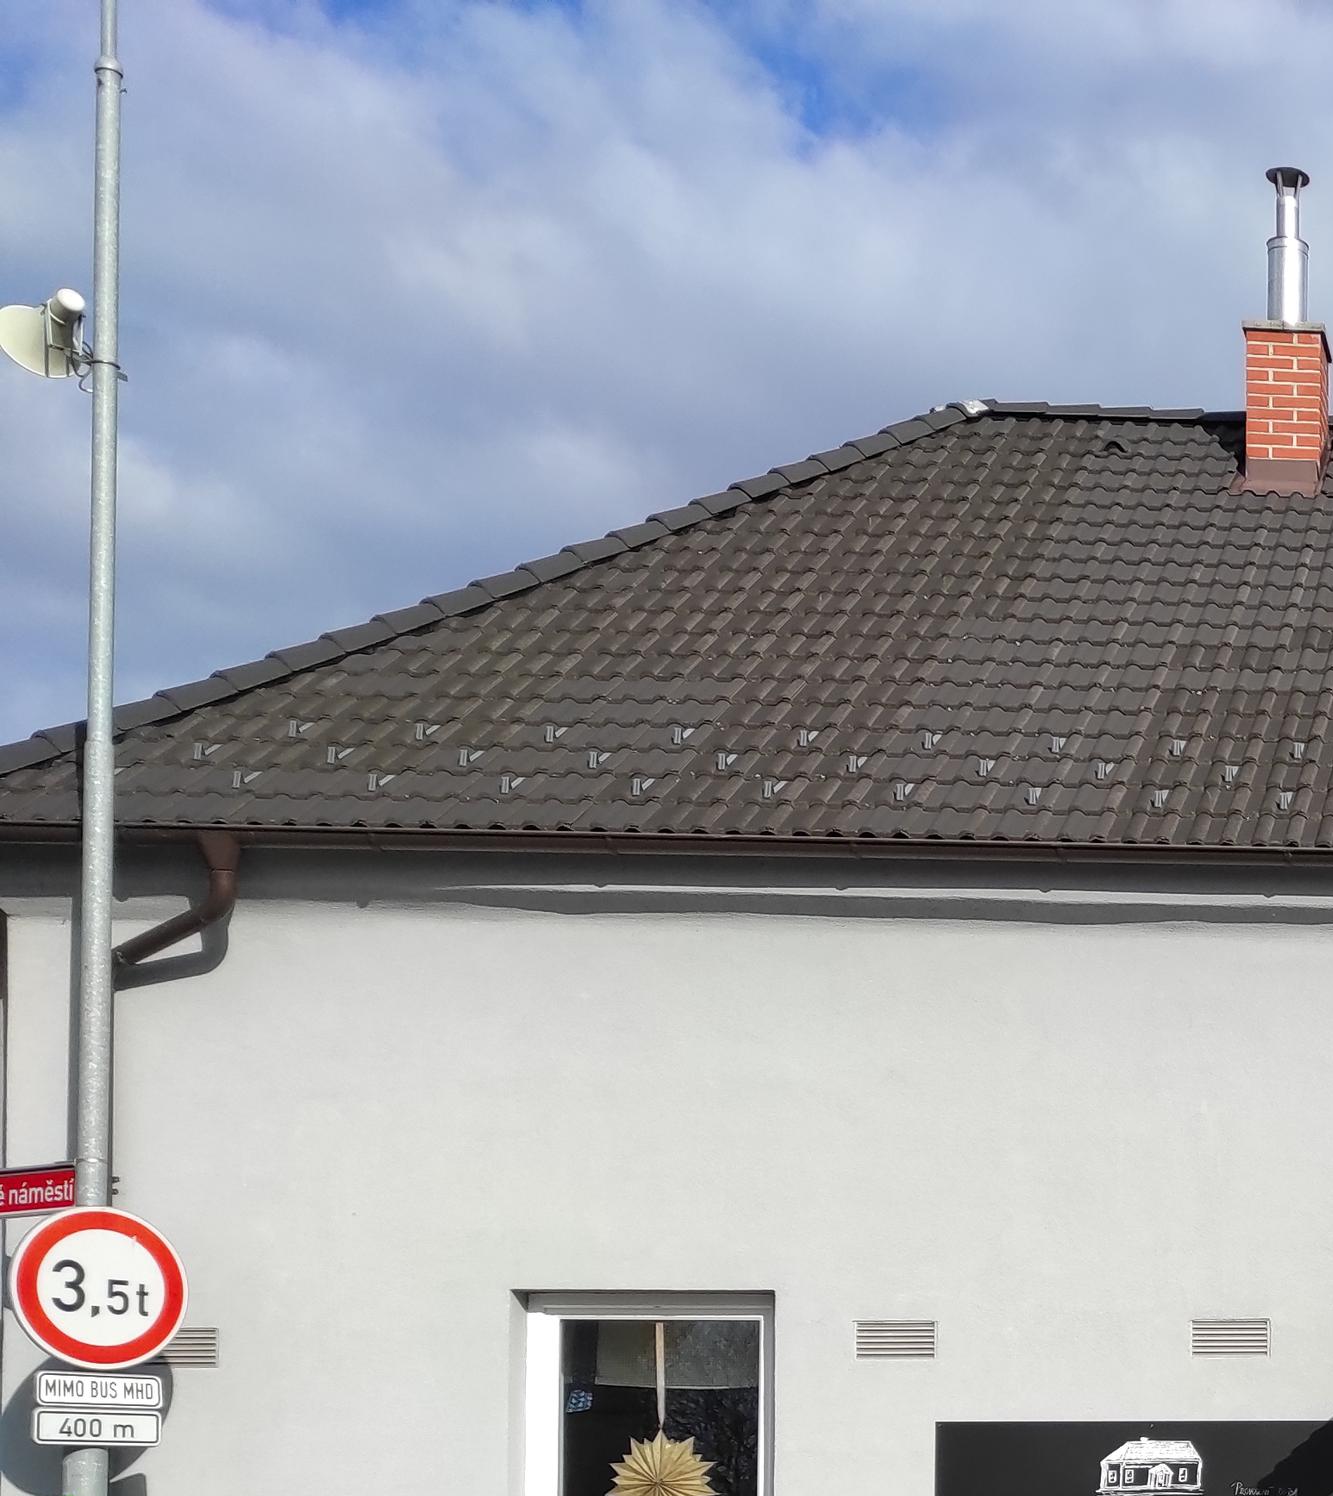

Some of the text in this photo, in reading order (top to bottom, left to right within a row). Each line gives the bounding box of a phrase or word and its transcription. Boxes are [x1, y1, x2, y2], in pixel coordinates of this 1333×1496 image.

[8, 1178, 75, 1206] náměstí
[45, 1379, 153, 1400] MIMO BUS MHD
[59, 1418, 135, 1438] 400 m
